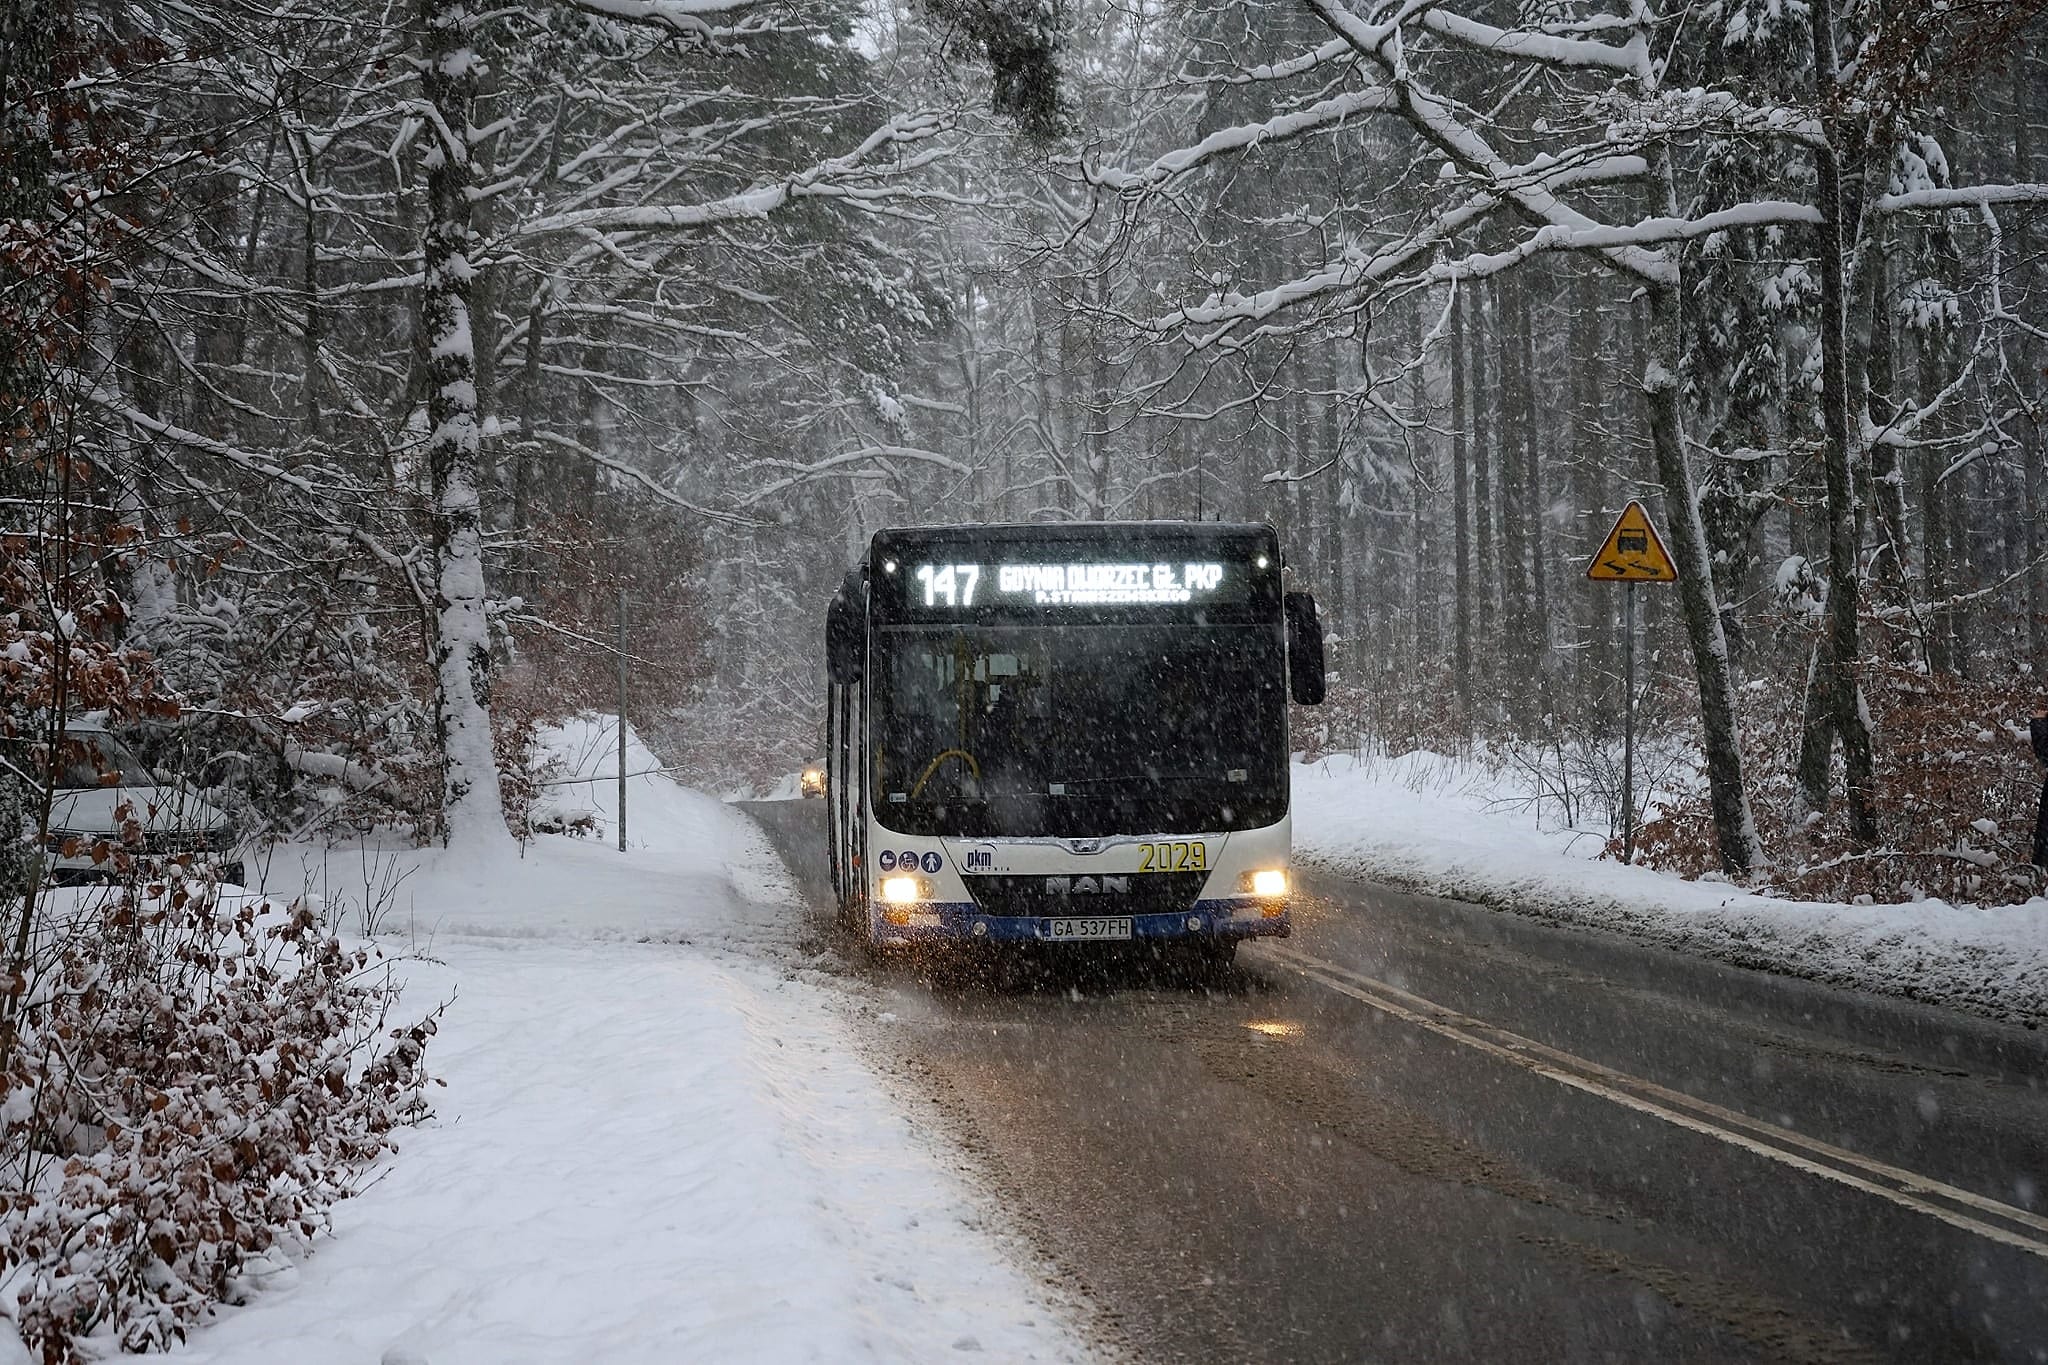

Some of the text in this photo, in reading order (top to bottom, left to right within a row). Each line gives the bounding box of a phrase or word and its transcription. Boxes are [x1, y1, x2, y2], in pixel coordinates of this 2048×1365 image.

[917, 564, 979, 605] 147
[999, 566, 1064, 590] GDYNIA
[1067, 566, 1149, 590] DWORZEC
[1185, 565, 1223, 588] PKP
[967, 849, 991, 868] pkm
[1138, 842, 1207, 873] 2029
[1046, 876, 1128, 895] MAN
[1054, 921, 1074, 936] GA
[1080, 920, 1129, 935] 537FH
